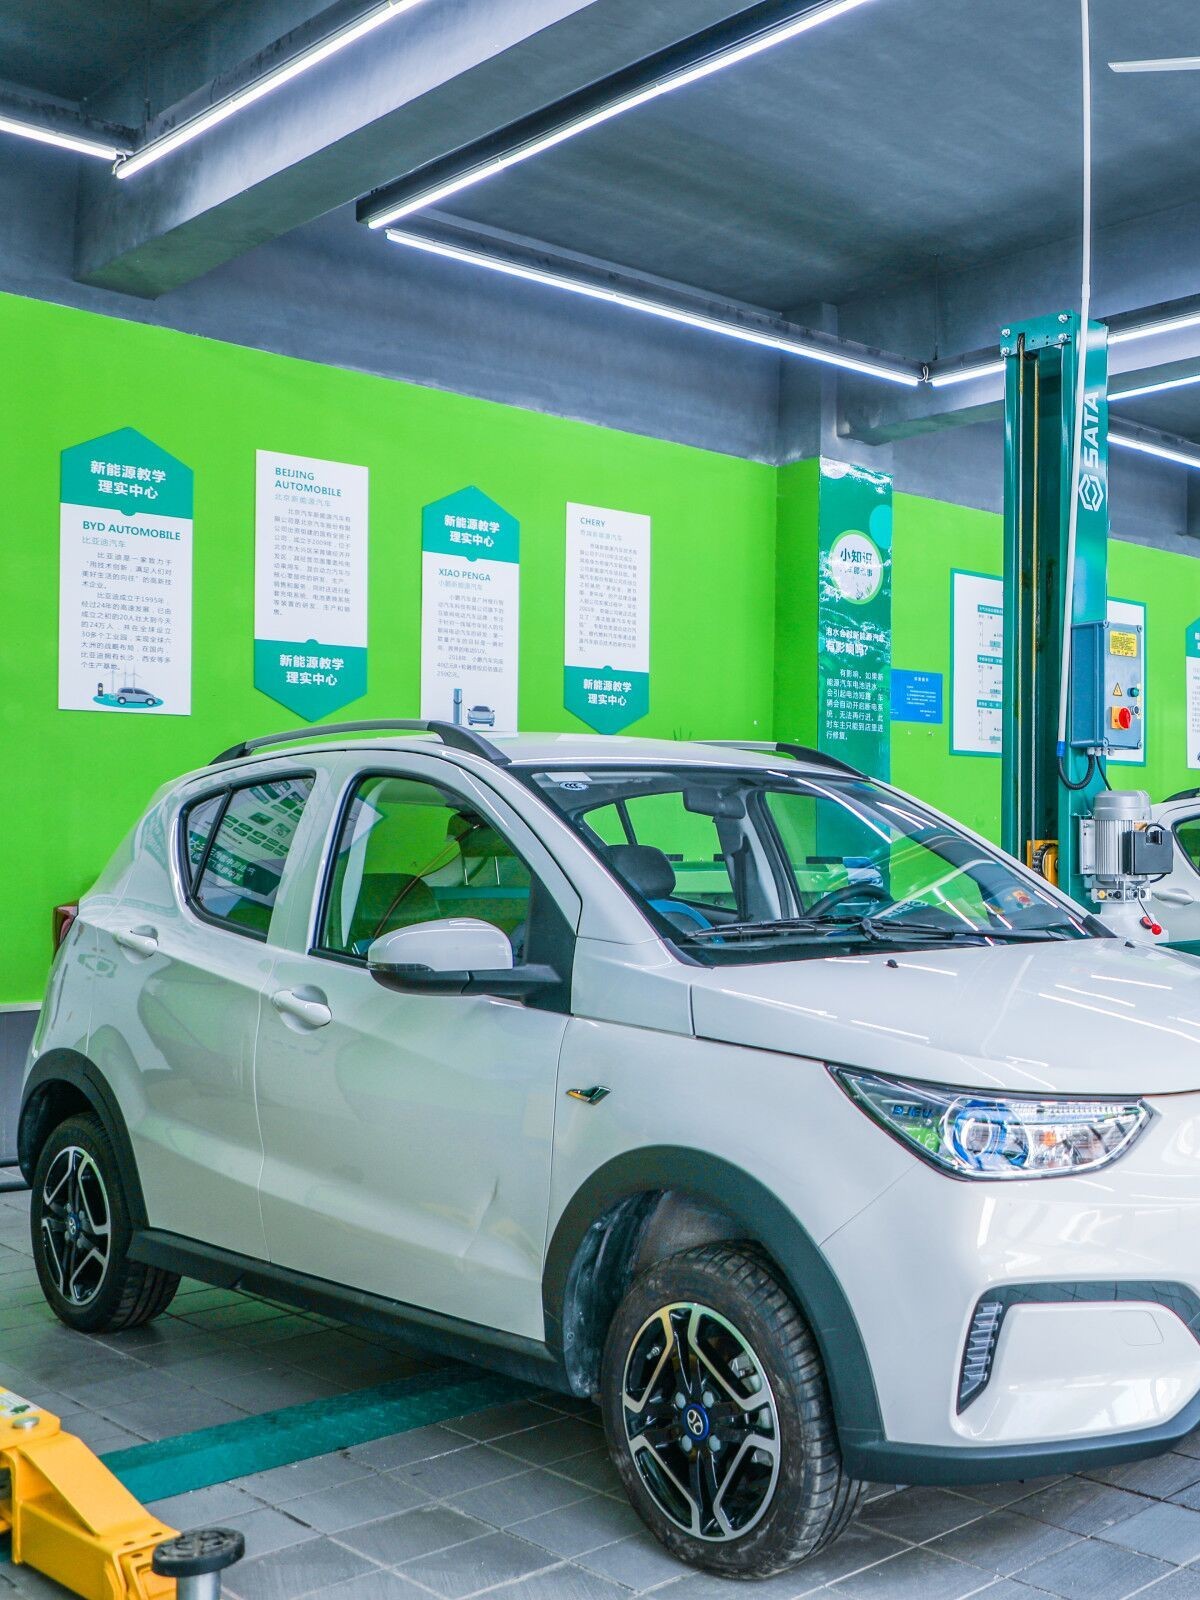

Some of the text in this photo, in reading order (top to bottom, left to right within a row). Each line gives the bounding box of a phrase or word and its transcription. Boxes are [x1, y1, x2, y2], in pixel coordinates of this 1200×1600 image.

[1083, 391, 1099, 469] SATA
[90, 460, 166, 483] 新能源教学
[275, 467, 315, 481] BEIJING
[98, 479, 158, 500] 理实中心
[275, 480, 342, 497] AUTOMOBILE
[82, 520, 181, 541] BYD AUTOMOBILE
[444, 514, 500, 533] 新能源教学
[580, 517, 606, 528] CHERY
[449, 530, 495, 548] 理实中心
[840, 547, 873, 564] 小知识
[438, 568, 491, 581] XIAO PENGA
[279, 654, 344, 671] 新能源教学
[286, 671, 338, 686] 理实中心
[583, 678, 632, 693] 新能源教学
[588, 693, 627, 707] 理实中心
